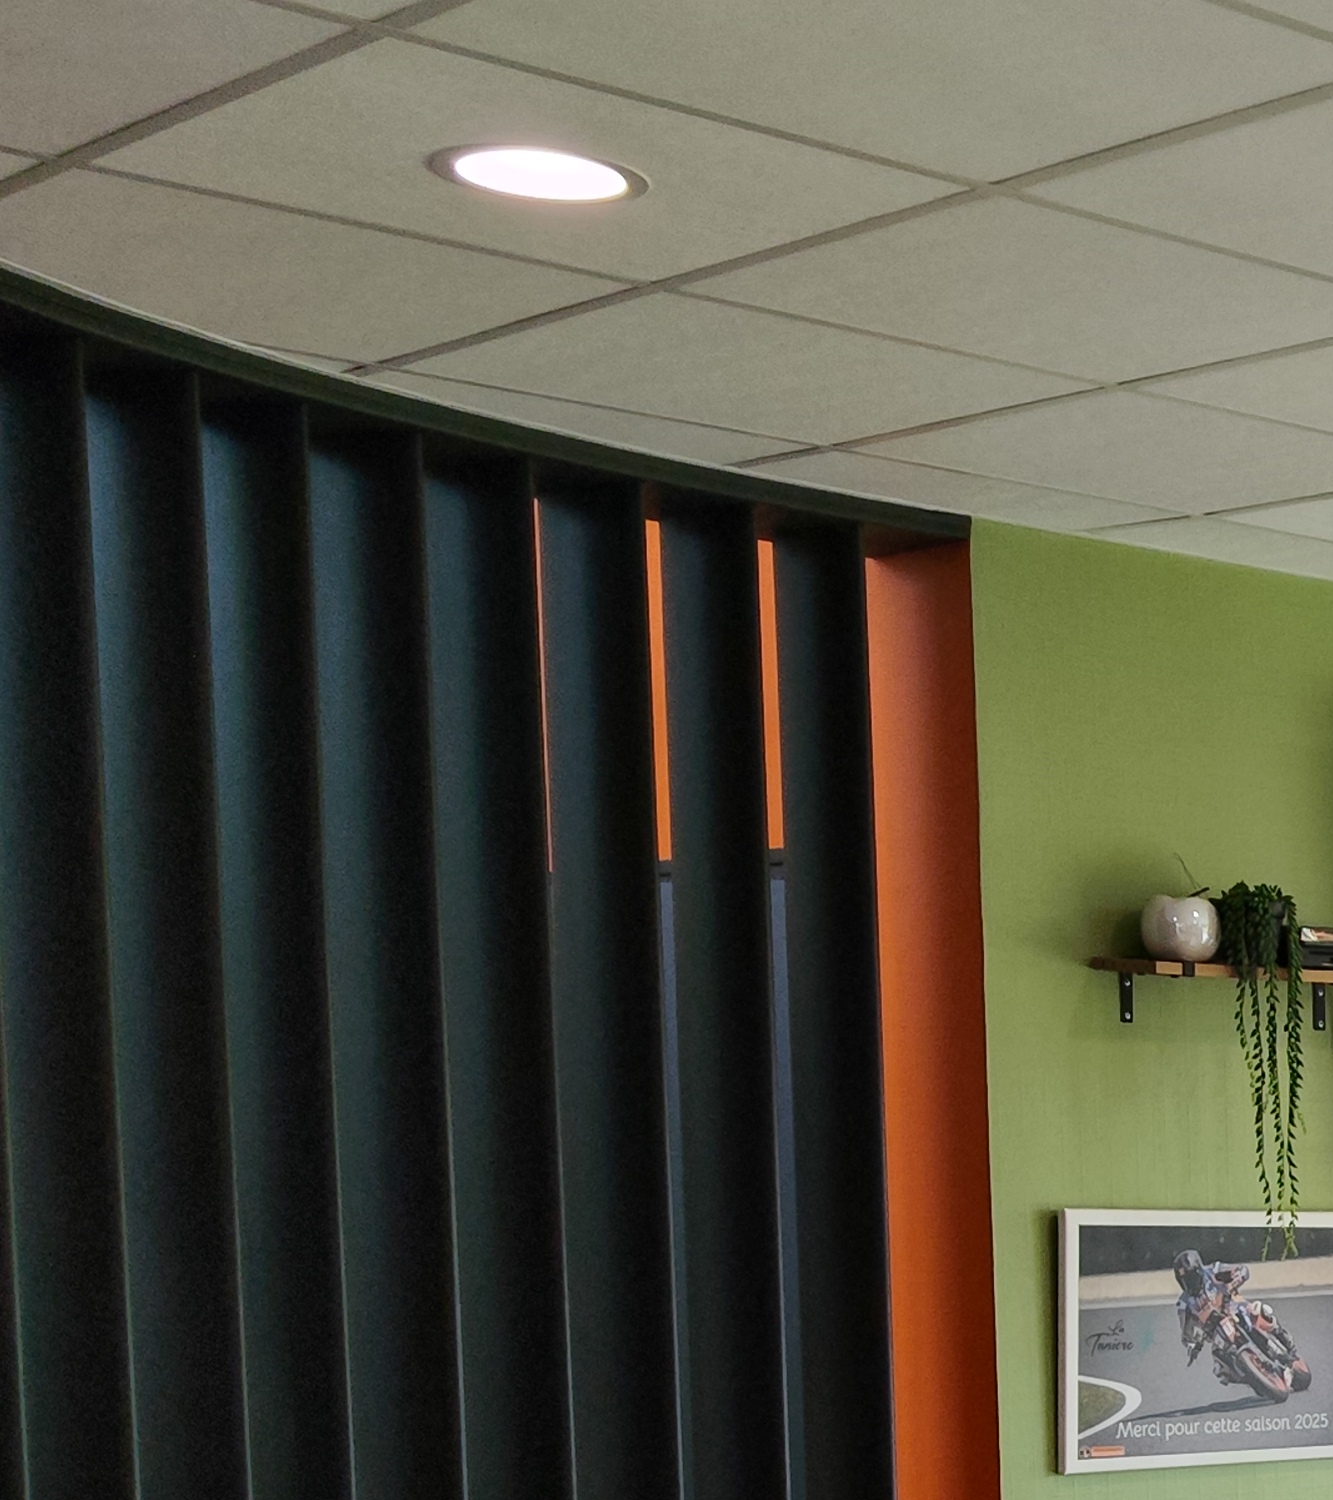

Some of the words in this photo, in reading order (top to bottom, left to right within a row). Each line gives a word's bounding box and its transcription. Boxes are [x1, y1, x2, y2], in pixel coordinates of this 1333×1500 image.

[1116, 1421, 1161, 1439] Merci
[1165, 1421, 1200, 1441] pour
[1203, 1418, 1241, 1434] cette
[1244, 1416, 1291, 1432] saison
[1294, 1413, 1329, 1430] 2025
